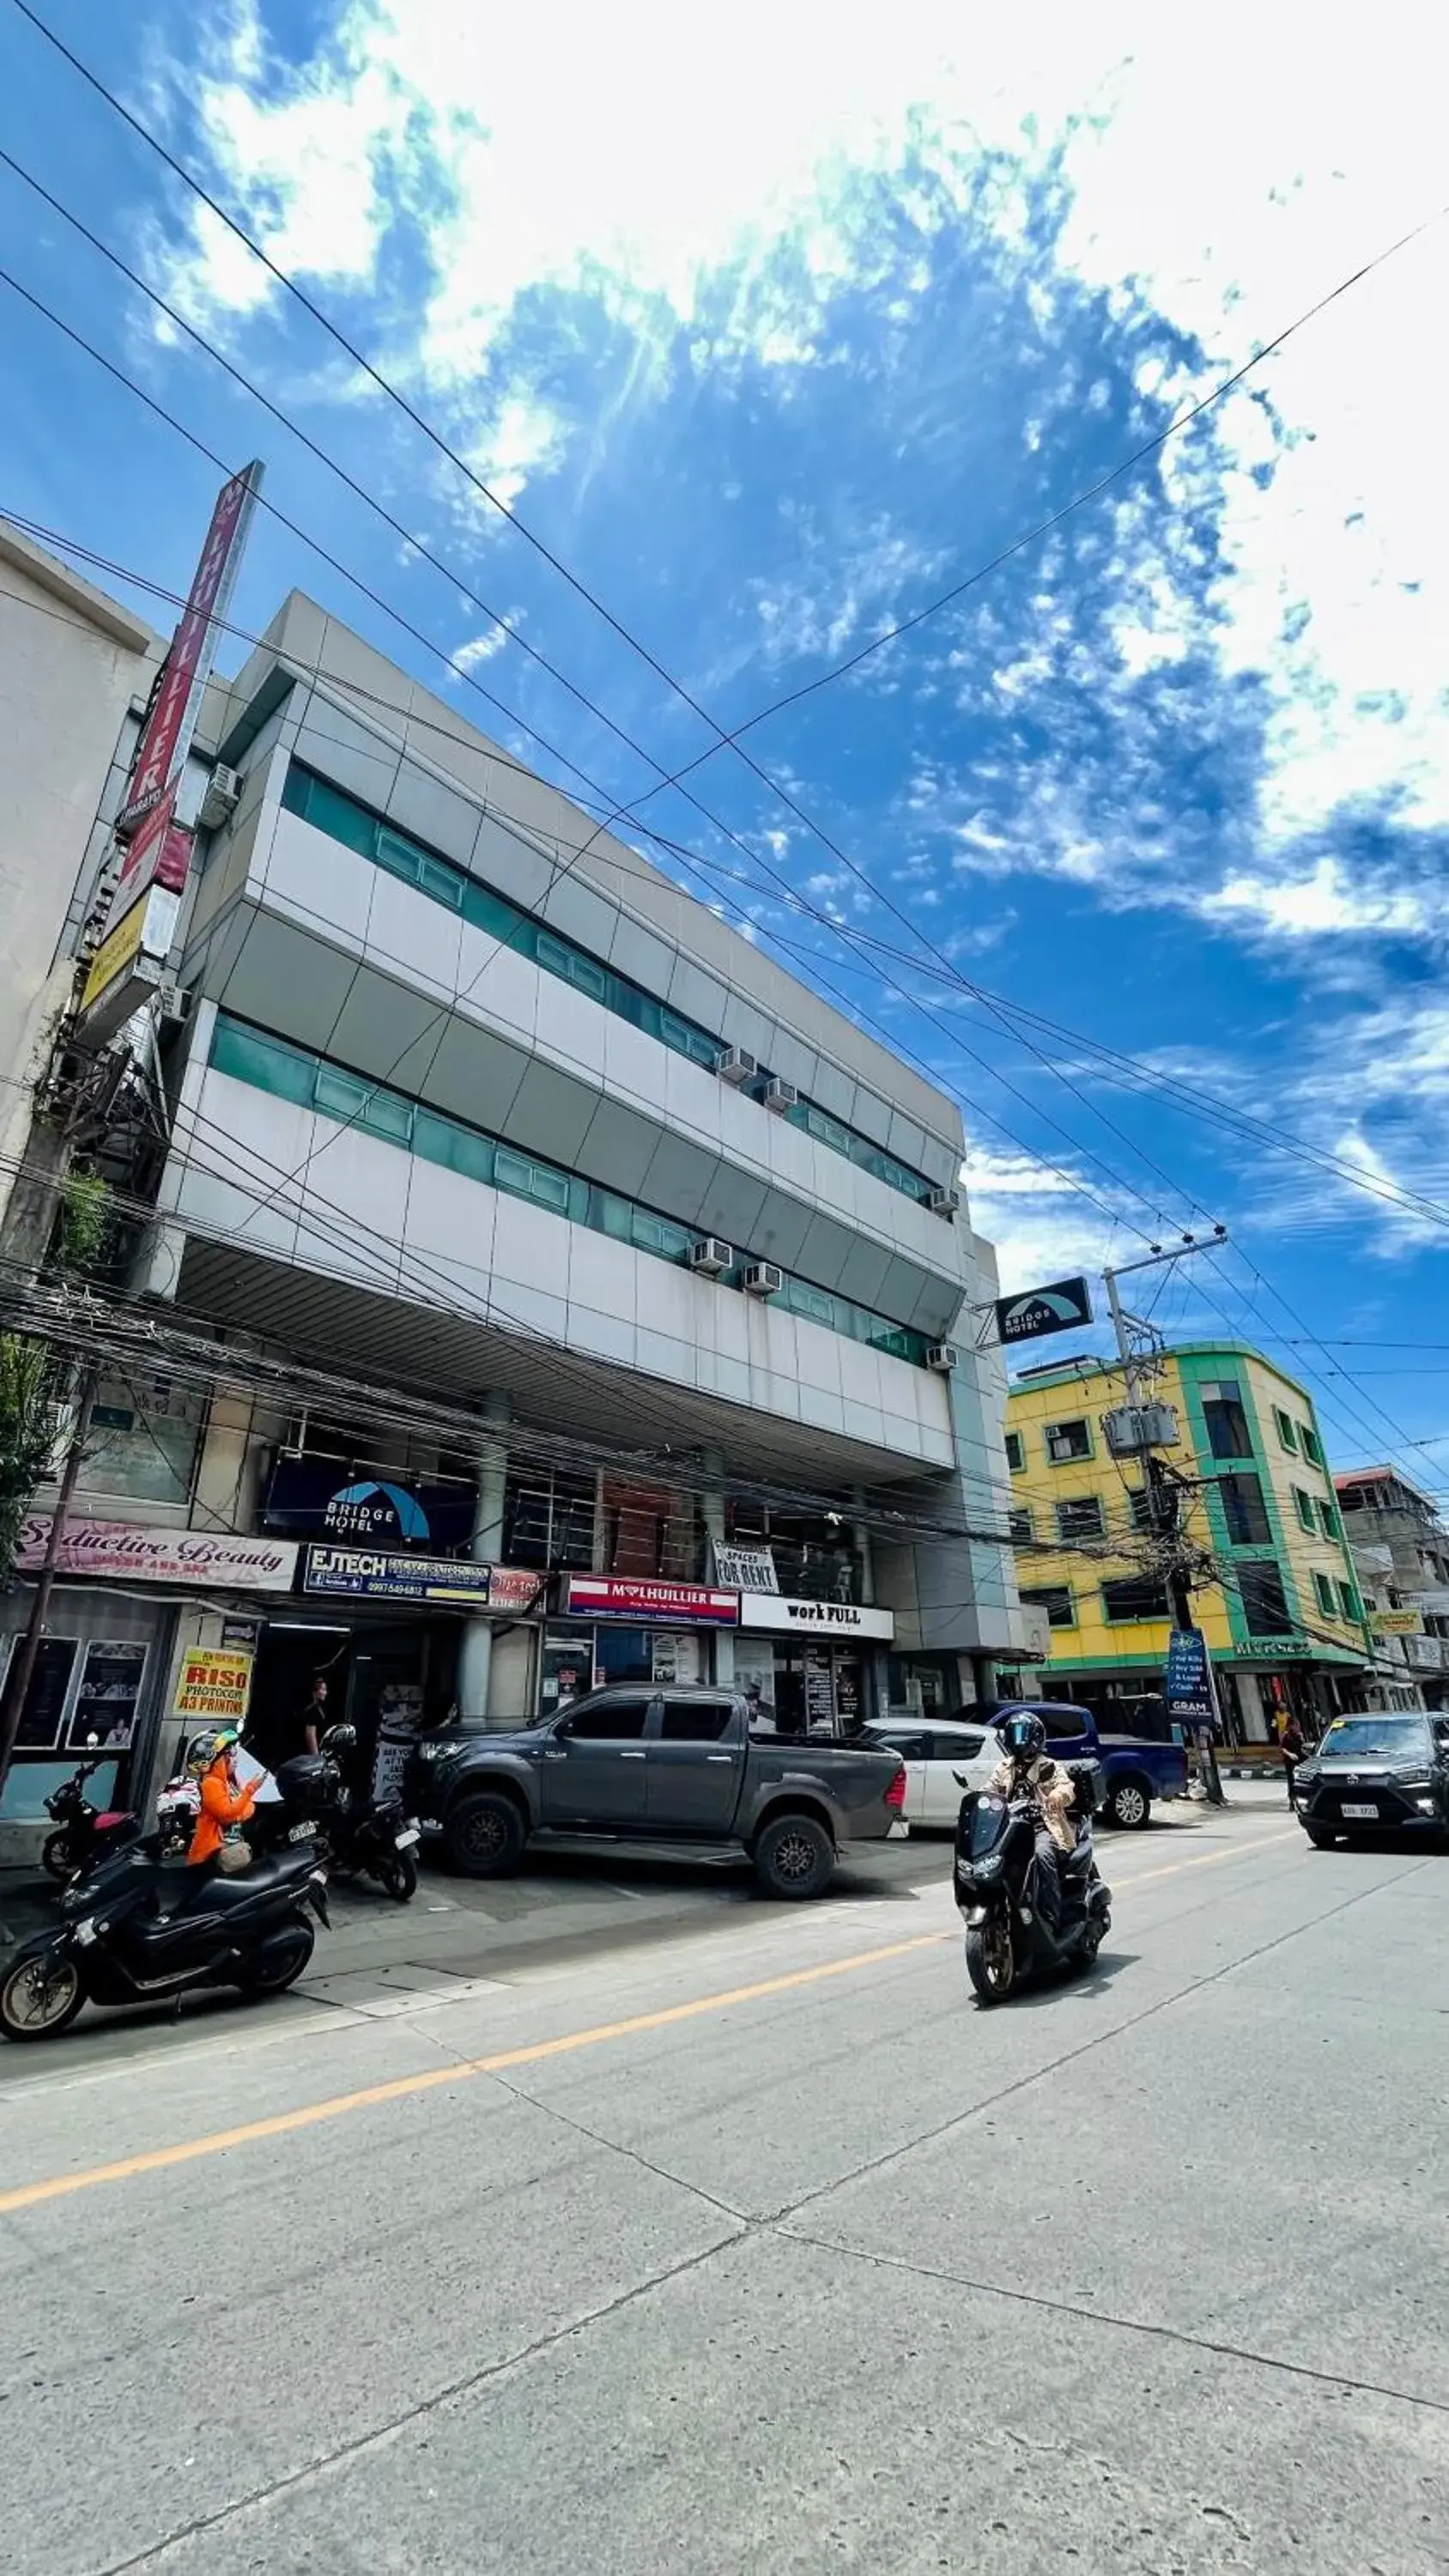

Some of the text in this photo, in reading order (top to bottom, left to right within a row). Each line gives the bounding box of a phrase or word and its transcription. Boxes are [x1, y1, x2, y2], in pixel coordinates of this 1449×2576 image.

[1005, 1321, 1039, 1334] HOTEL
[327, 1502, 395, 1522] BRIDGE
[324, 1515, 373, 1532] HOTEL
[178, 1538, 284, 1571] Beauty
[312, 1549, 386, 1577] EJTECH
[728, 1551, 758, 1564] SPACES
[718, 1559, 773, 1588] FOR RENT
[185, 1667, 247, 1689] RISO
[179, 1696, 197, 1710] A3
[1173, 1700, 1206, 1712] GRAM
